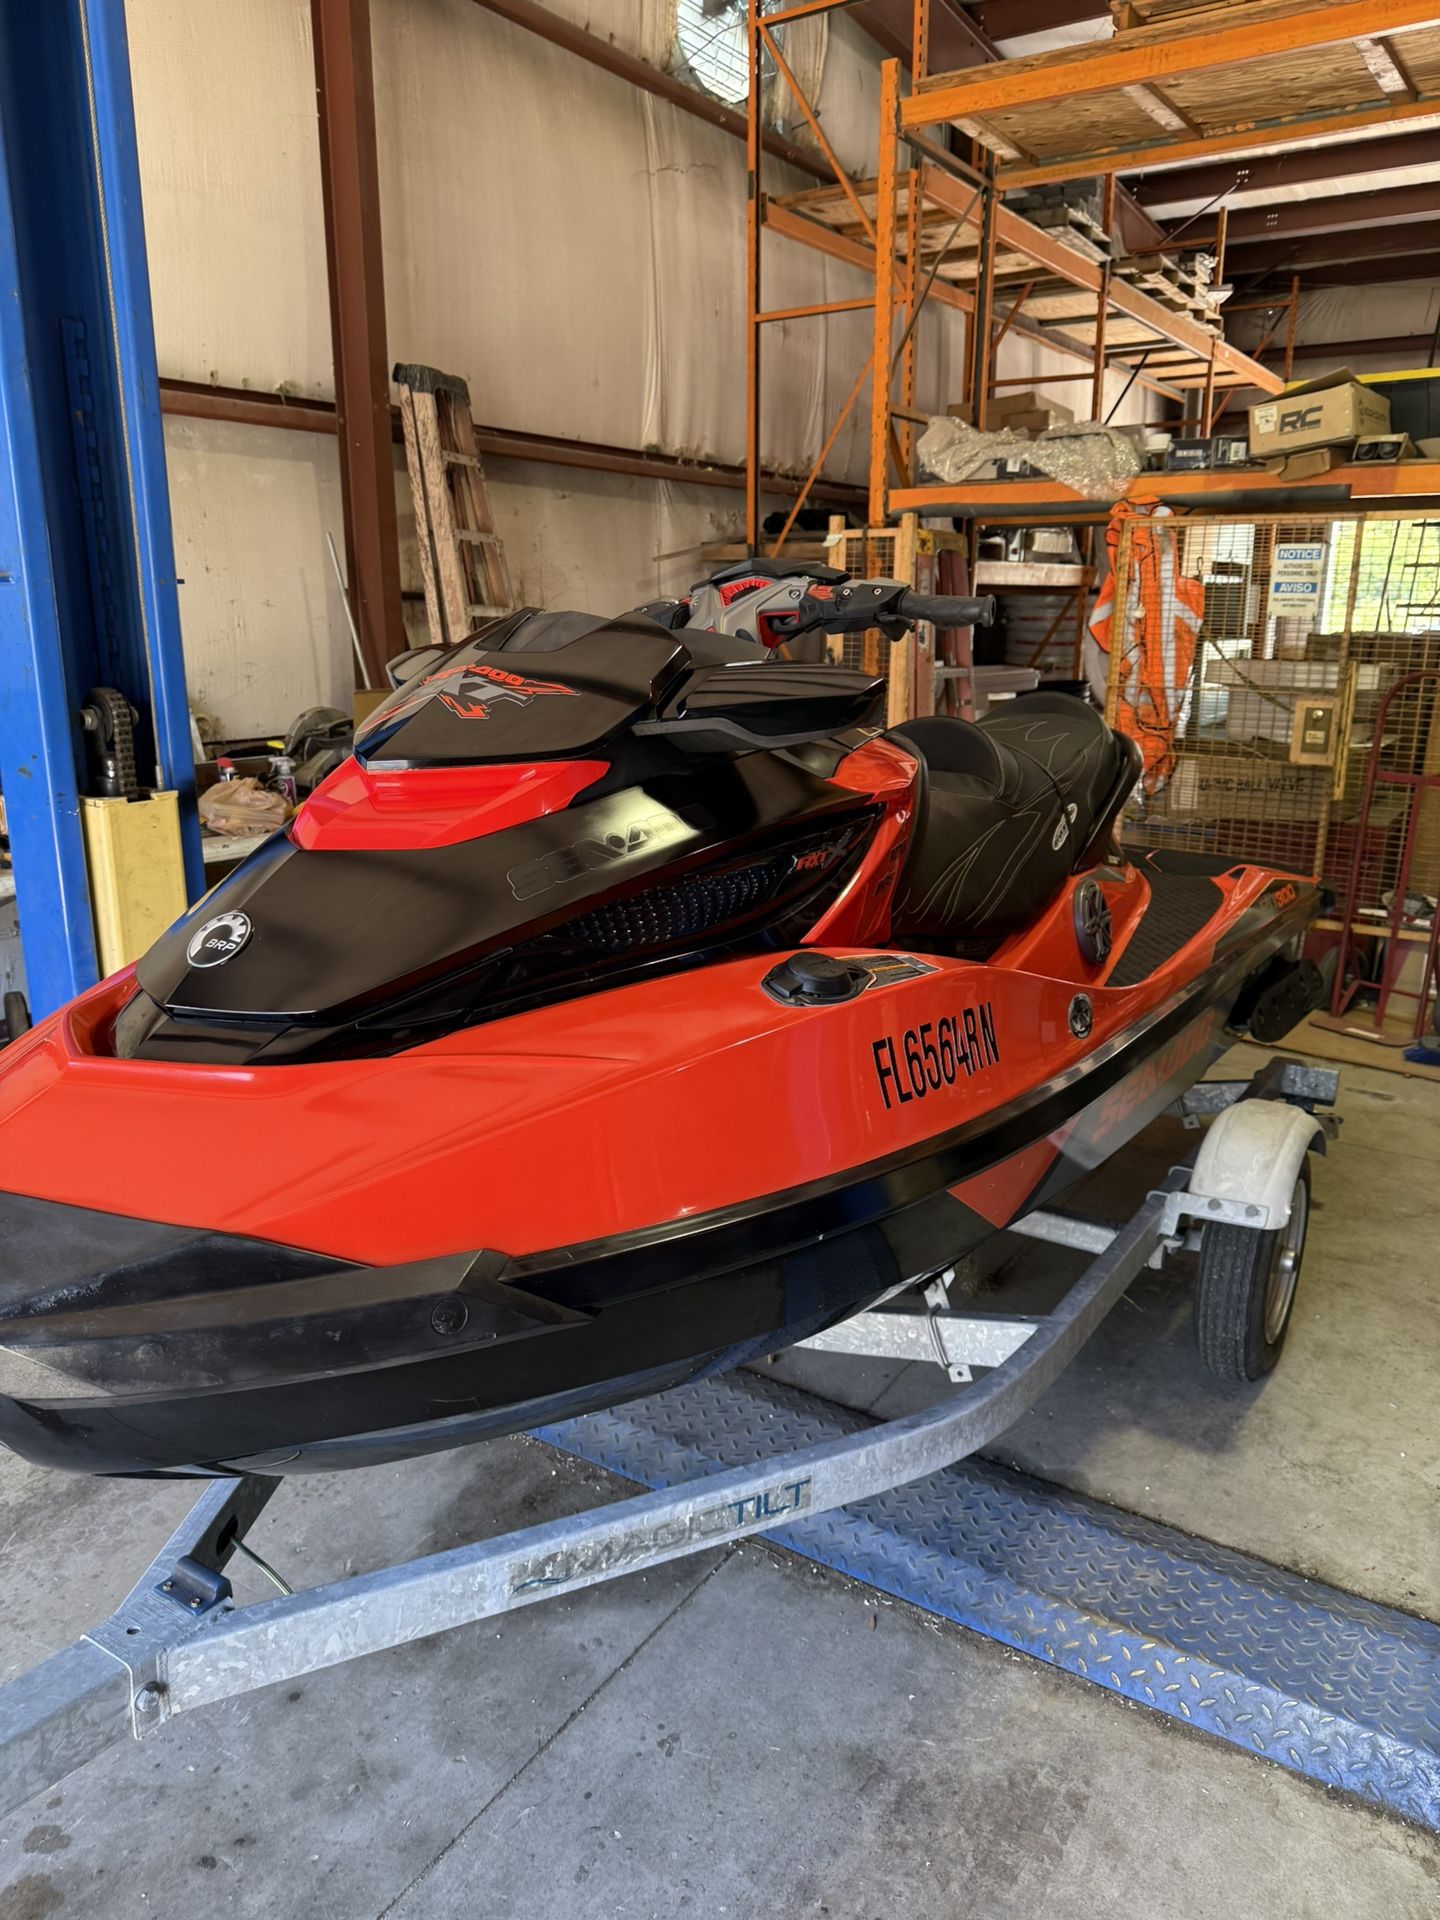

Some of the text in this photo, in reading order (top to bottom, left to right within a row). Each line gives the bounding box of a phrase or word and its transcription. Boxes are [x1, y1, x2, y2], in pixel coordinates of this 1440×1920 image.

[1279, 405, 1323, 434] RC
[1280, 549, 1321, 560] NOTICE
[1279, 583, 1312, 593] AVISO
[1267, 777, 1304, 791] VALVE
[205, 938, 237, 951] BRP
[727, 1479, 812, 1524] TILT
